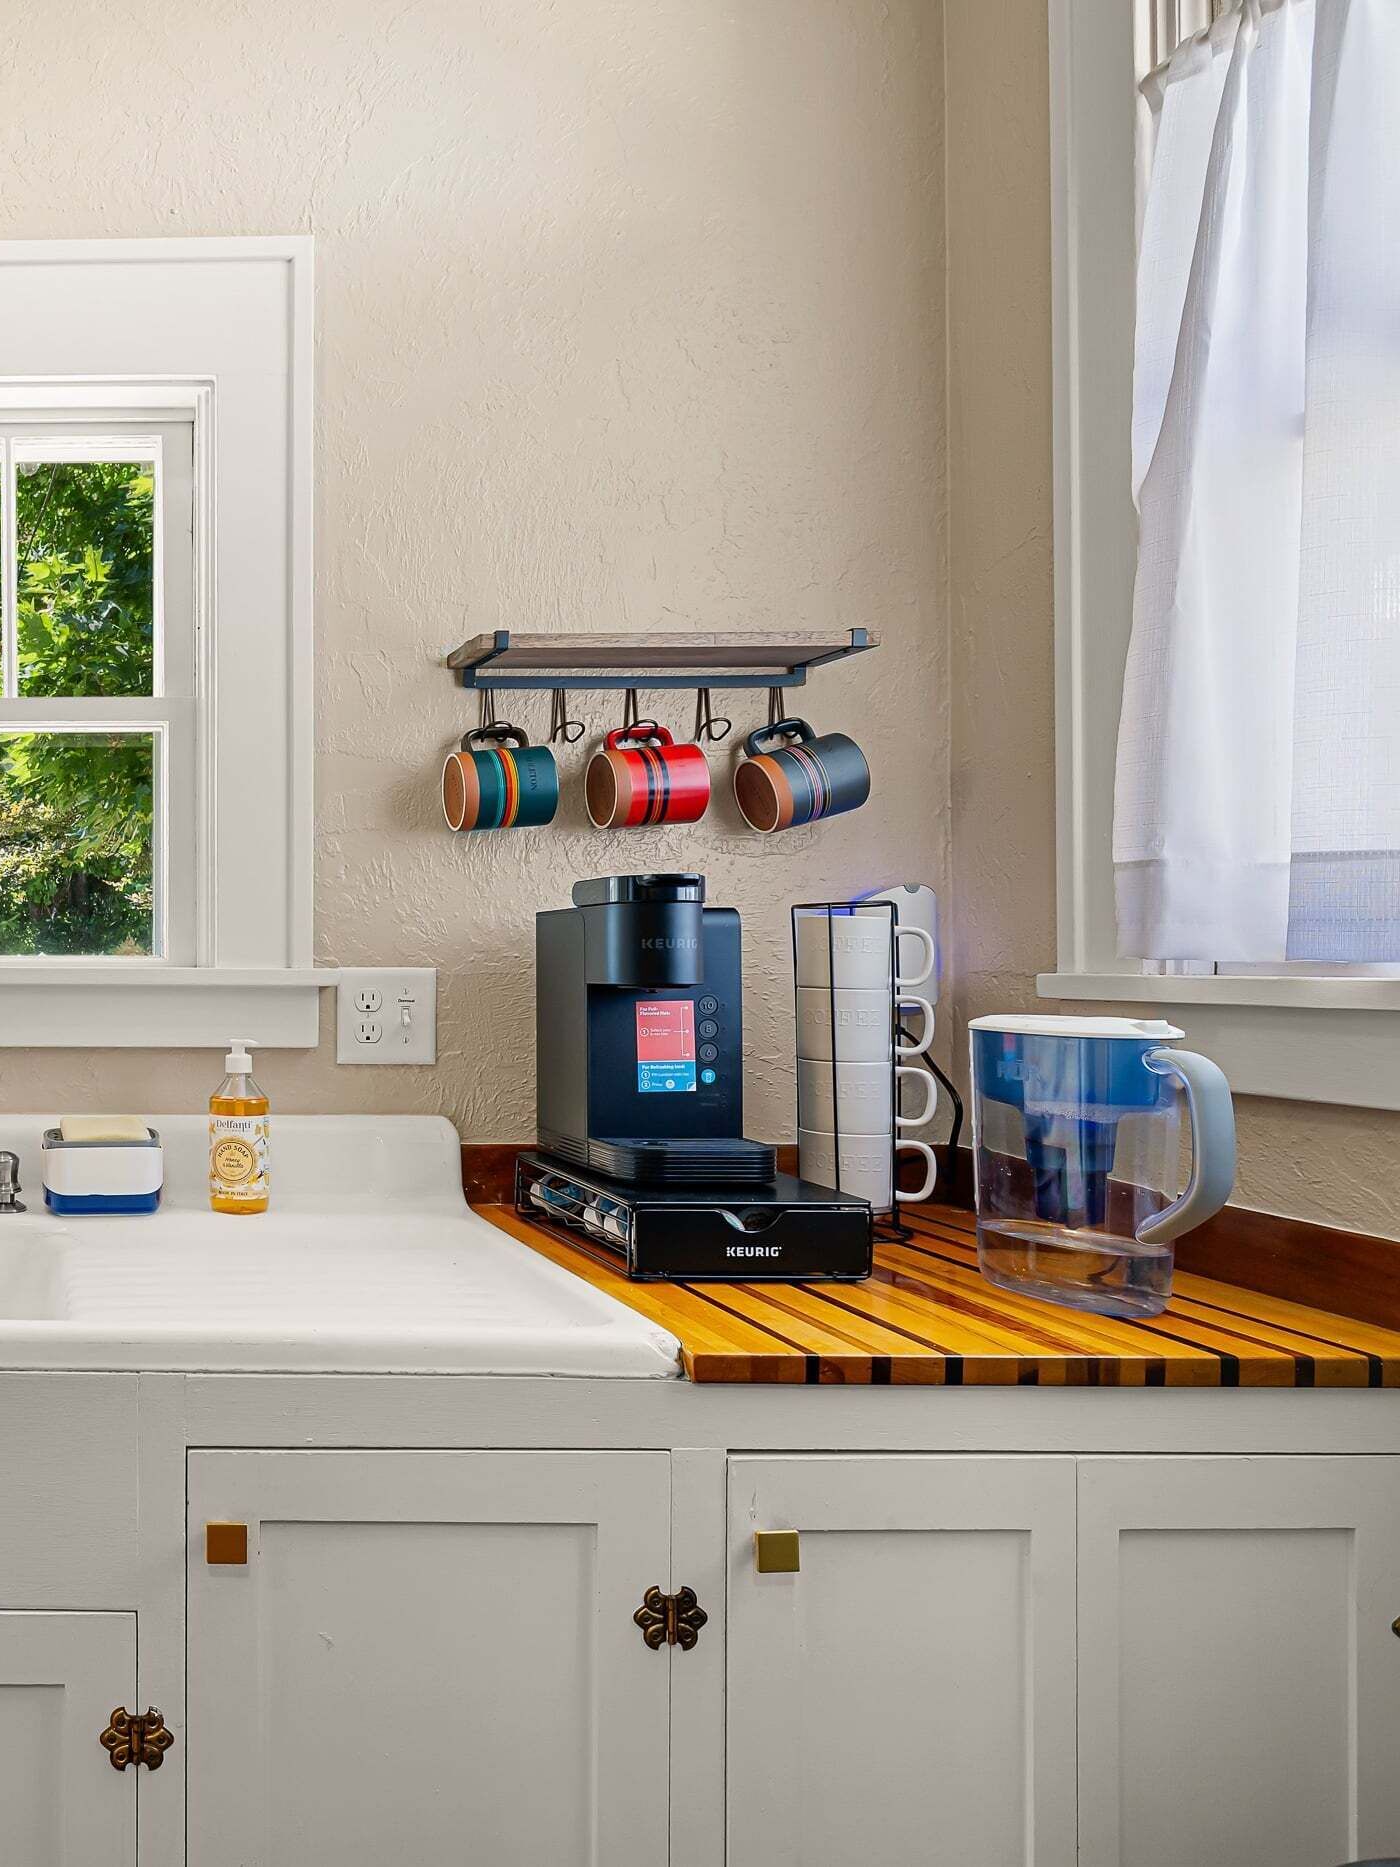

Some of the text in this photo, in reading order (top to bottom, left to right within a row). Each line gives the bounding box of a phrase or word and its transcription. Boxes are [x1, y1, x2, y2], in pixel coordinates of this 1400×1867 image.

[703, 1002, 714, 1010] 10
[804, 1008, 881, 1026] COFFEE
[806, 1080, 881, 1098] COFFEE
[807, 1152, 883, 1172] COFFEE
[726, 1246, 779, 1257] KEURIG
